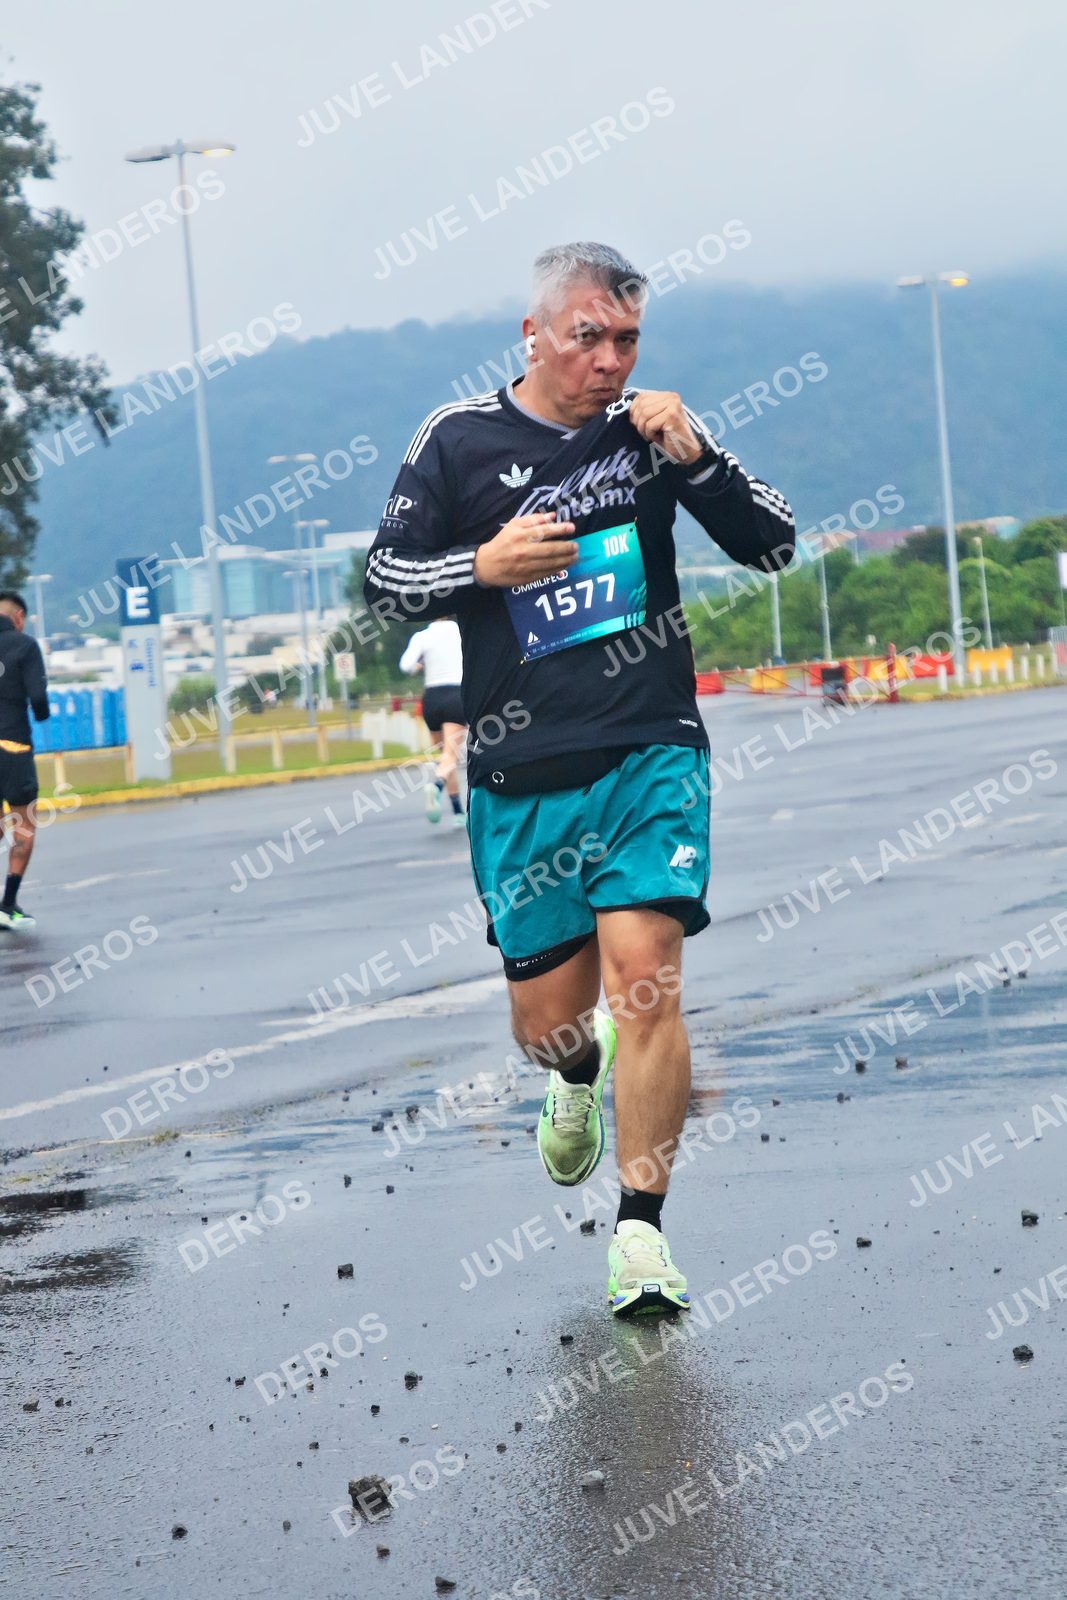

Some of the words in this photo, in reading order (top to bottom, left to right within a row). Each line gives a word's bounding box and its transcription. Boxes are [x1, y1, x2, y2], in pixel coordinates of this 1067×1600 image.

[603, 532, 630, 558] 10K
[512, 574, 559, 595] OMNILIFE
[534, 572, 616, 622] 1577
[127, 585, 151, 619] E
